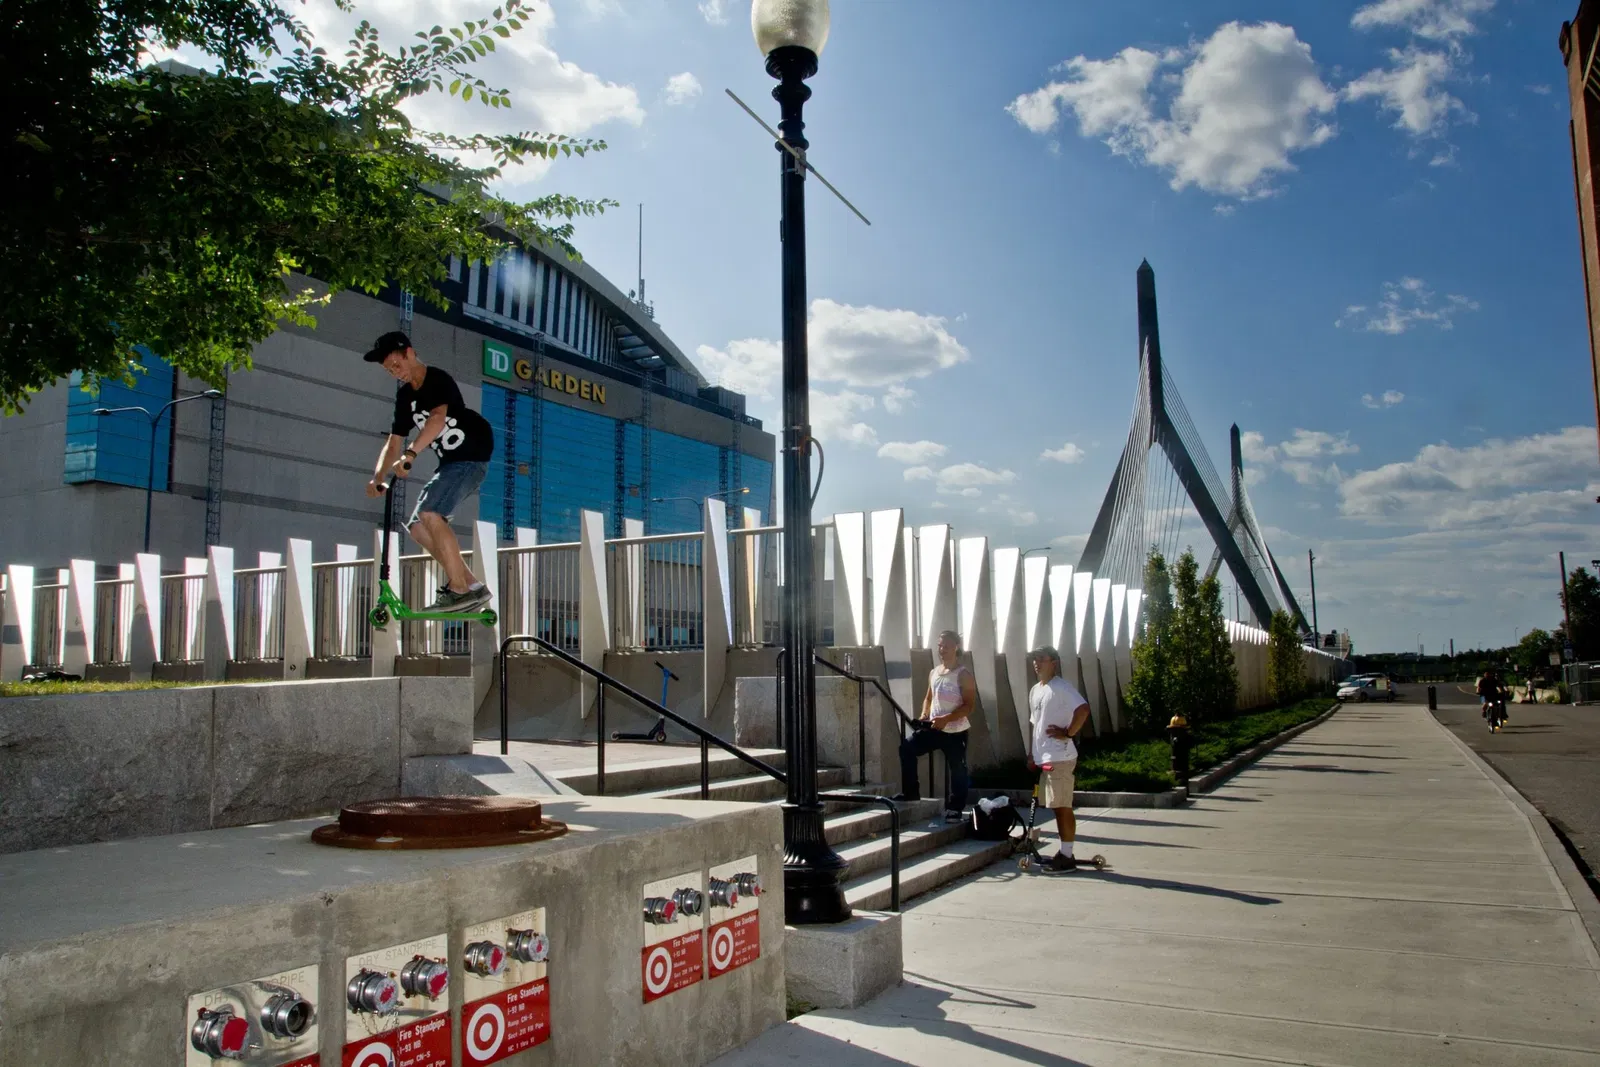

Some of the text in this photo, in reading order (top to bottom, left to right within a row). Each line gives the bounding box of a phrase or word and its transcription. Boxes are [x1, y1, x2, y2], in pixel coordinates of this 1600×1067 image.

[487, 347, 606, 404] TD GARDEN
[385, 938, 437, 961] STANDPIPE
[507, 984, 545, 1004] Fire Standpipe
[507, 1005, 517, 1015] I-93
[399, 1018, 445, 1041] Fire Standpipe
[535, 1022, 544, 1030] Pipe
[399, 1040, 421, 1055] I-93 NB
[400, 1058, 414, 1067] Ramp
[416, 1050, 431, 1061] CN-S
